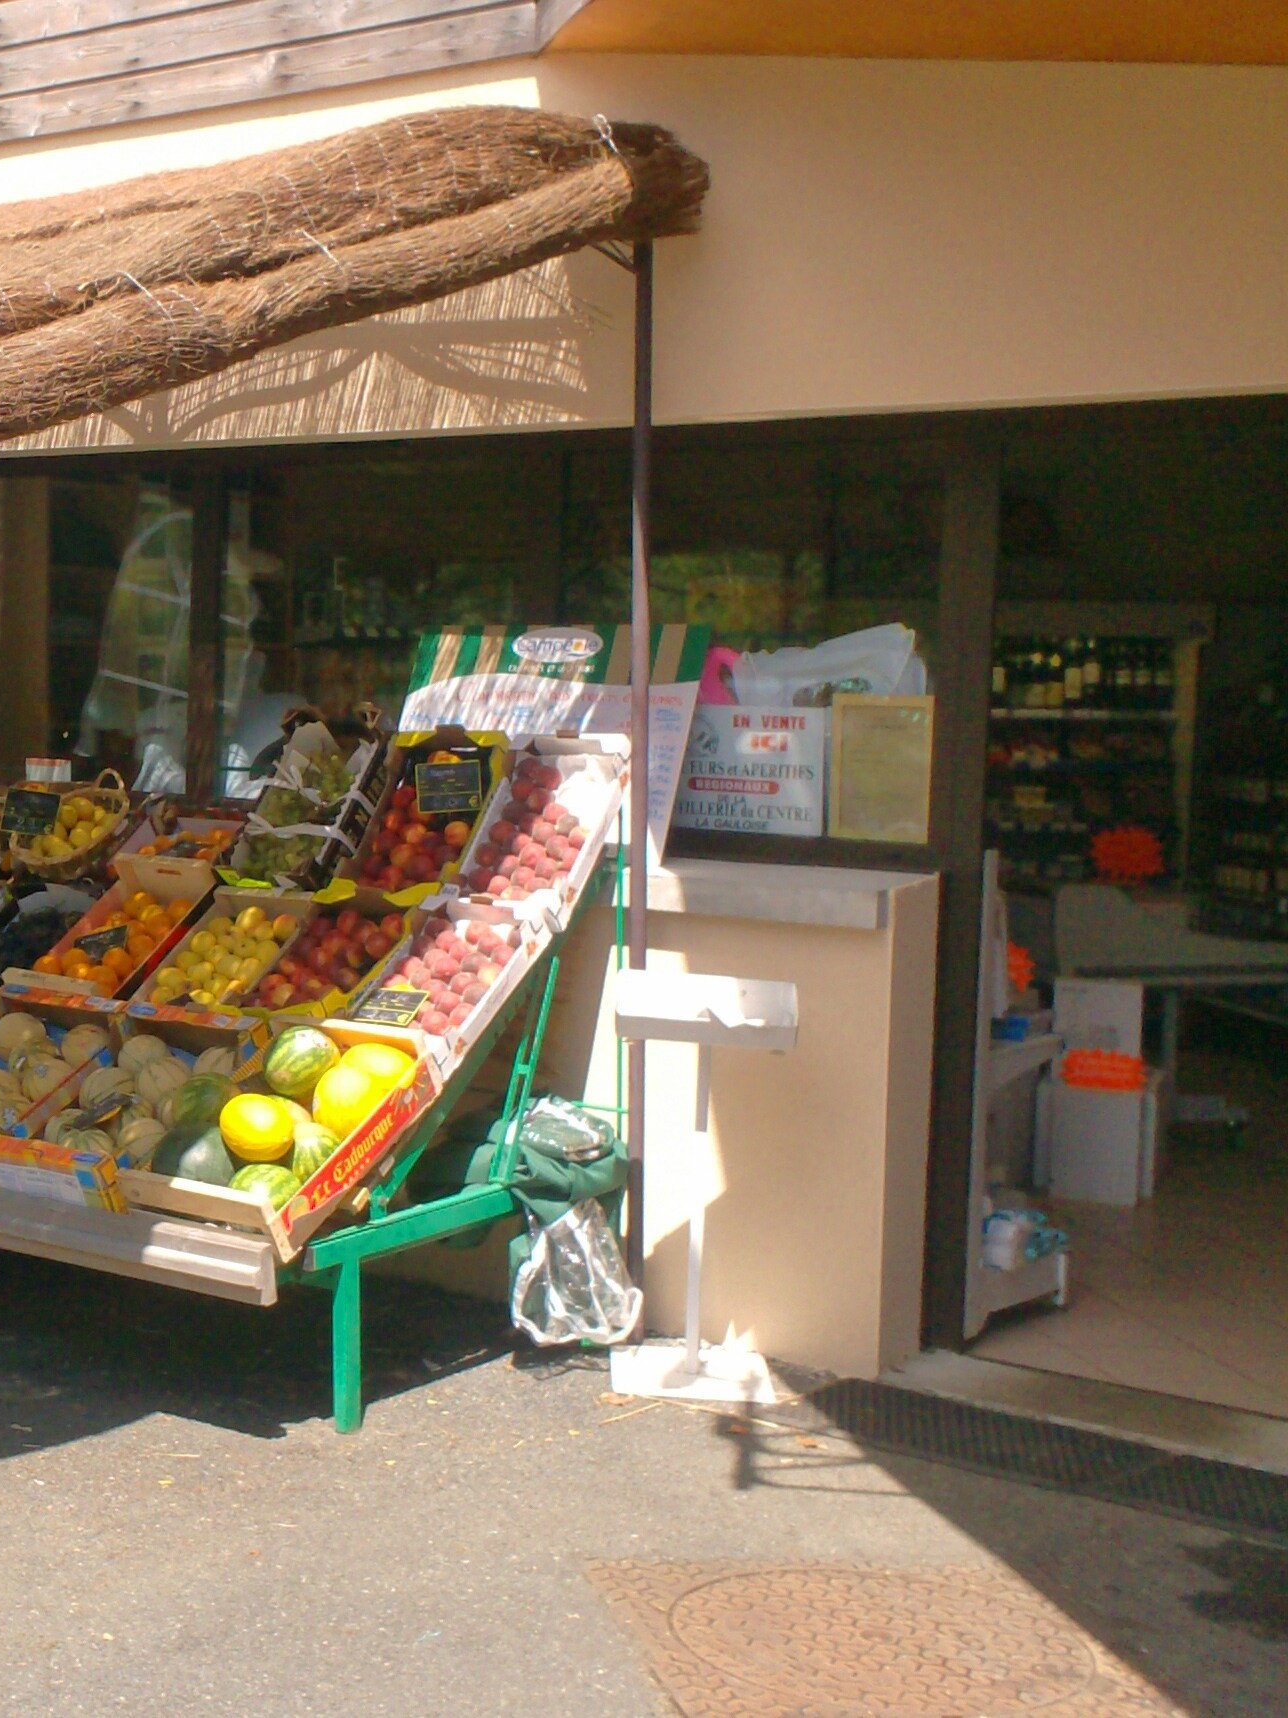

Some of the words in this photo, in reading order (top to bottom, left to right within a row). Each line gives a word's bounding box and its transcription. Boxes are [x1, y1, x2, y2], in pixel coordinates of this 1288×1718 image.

[733, 714, 750, 729] EN
[762, 715, 806, 730] VENTE
[750, 734, 789, 752] ICI
[688, 760, 725, 775] EURS
[727, 764, 739, 777] et
[741, 801, 754, 818] du
[757, 804, 811, 822] CENTRE
[695, 818, 709, 828] LA
